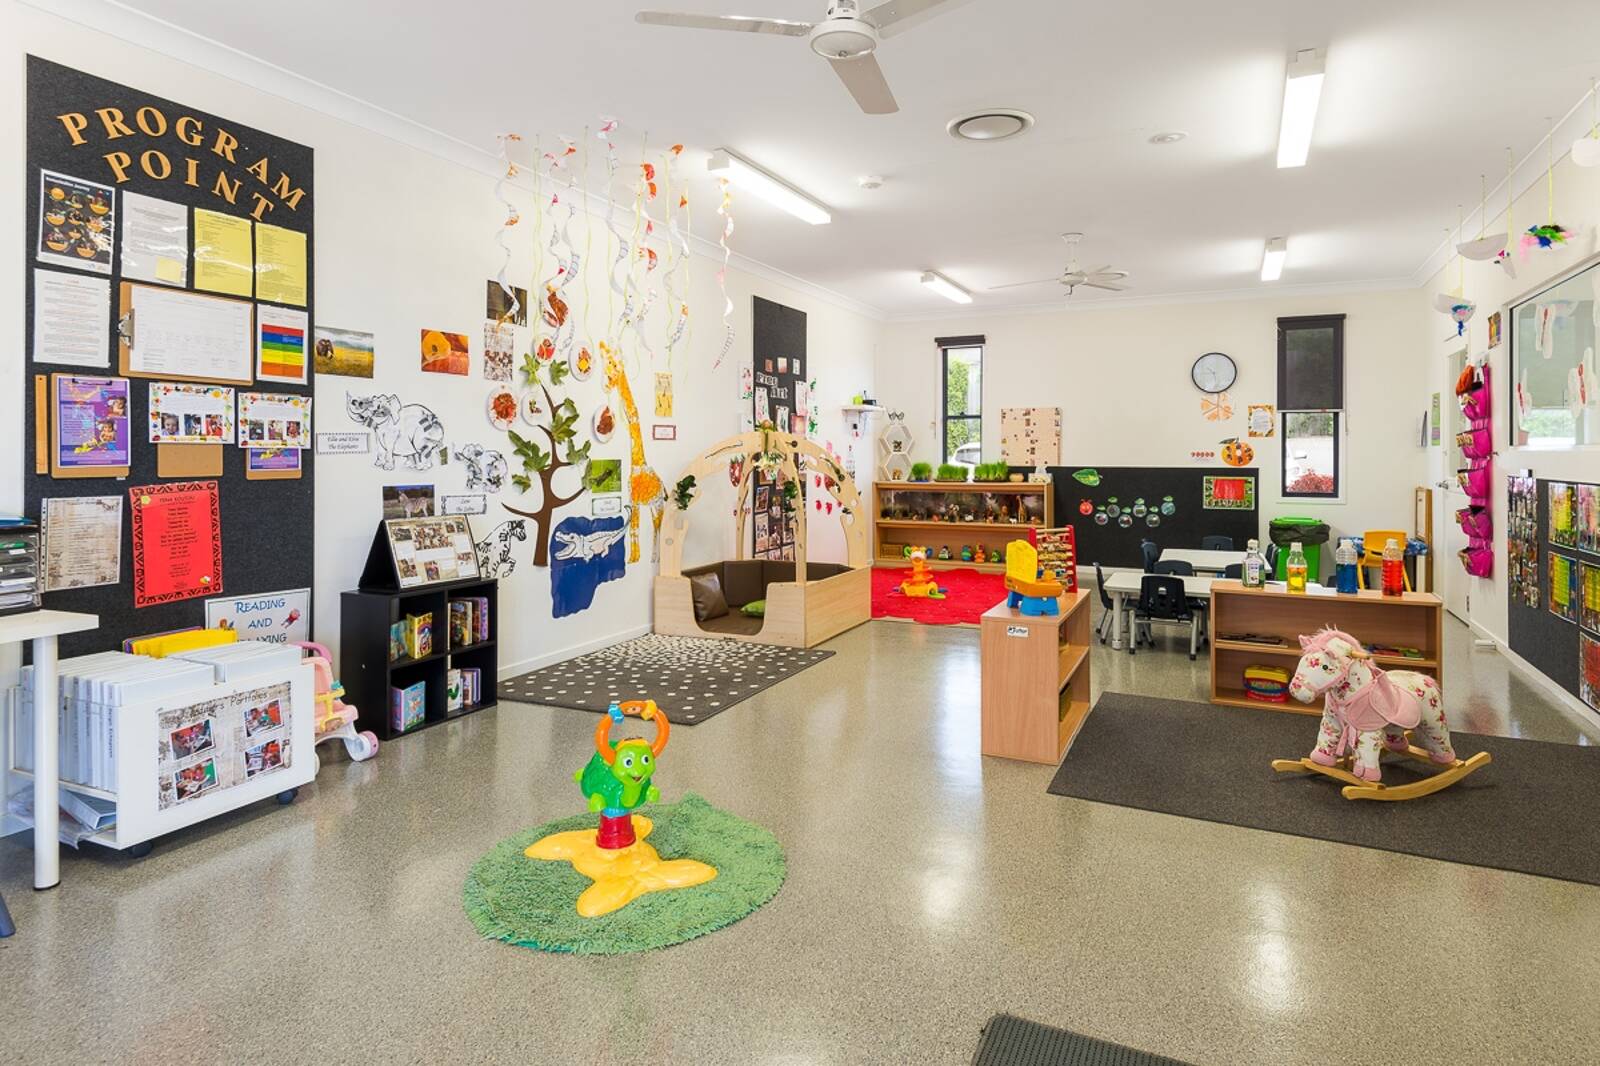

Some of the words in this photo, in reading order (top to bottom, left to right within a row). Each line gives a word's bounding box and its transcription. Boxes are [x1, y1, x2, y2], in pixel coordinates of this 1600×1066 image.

[57, 106, 306, 212] PROGRAM
[103, 150, 274, 222] POINT
[235, 598, 286, 613] READING
[248, 617, 273, 629] AND
